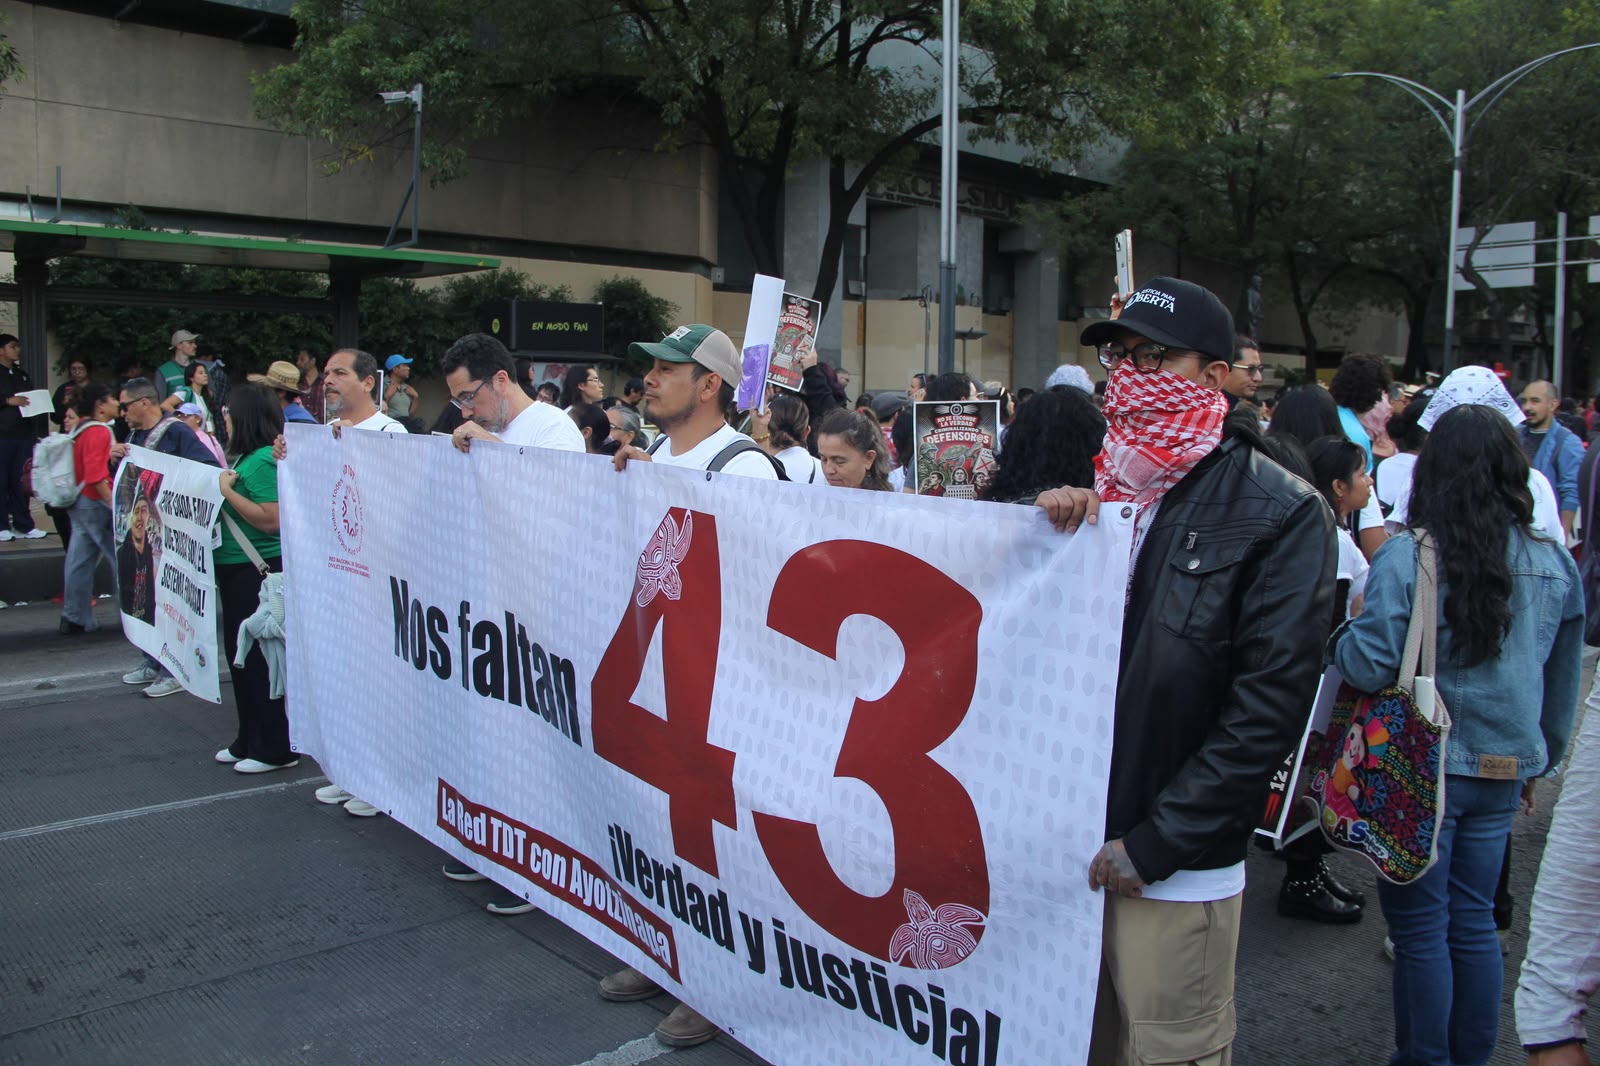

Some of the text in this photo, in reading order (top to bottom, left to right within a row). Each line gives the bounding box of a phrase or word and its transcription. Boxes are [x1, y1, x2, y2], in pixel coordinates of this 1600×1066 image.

[531, 321, 588, 332] EN MODO FAN
[926, 432, 990, 444] DEFENSOR@S
[390, 576, 582, 747] Nos faltan
[591, 507, 990, 969] 43
[441, 786, 672, 969] La Red TDT con Ayotzinapa
[608, 823, 735, 954] ¡Verdad
[738, 910, 766, 974] y
